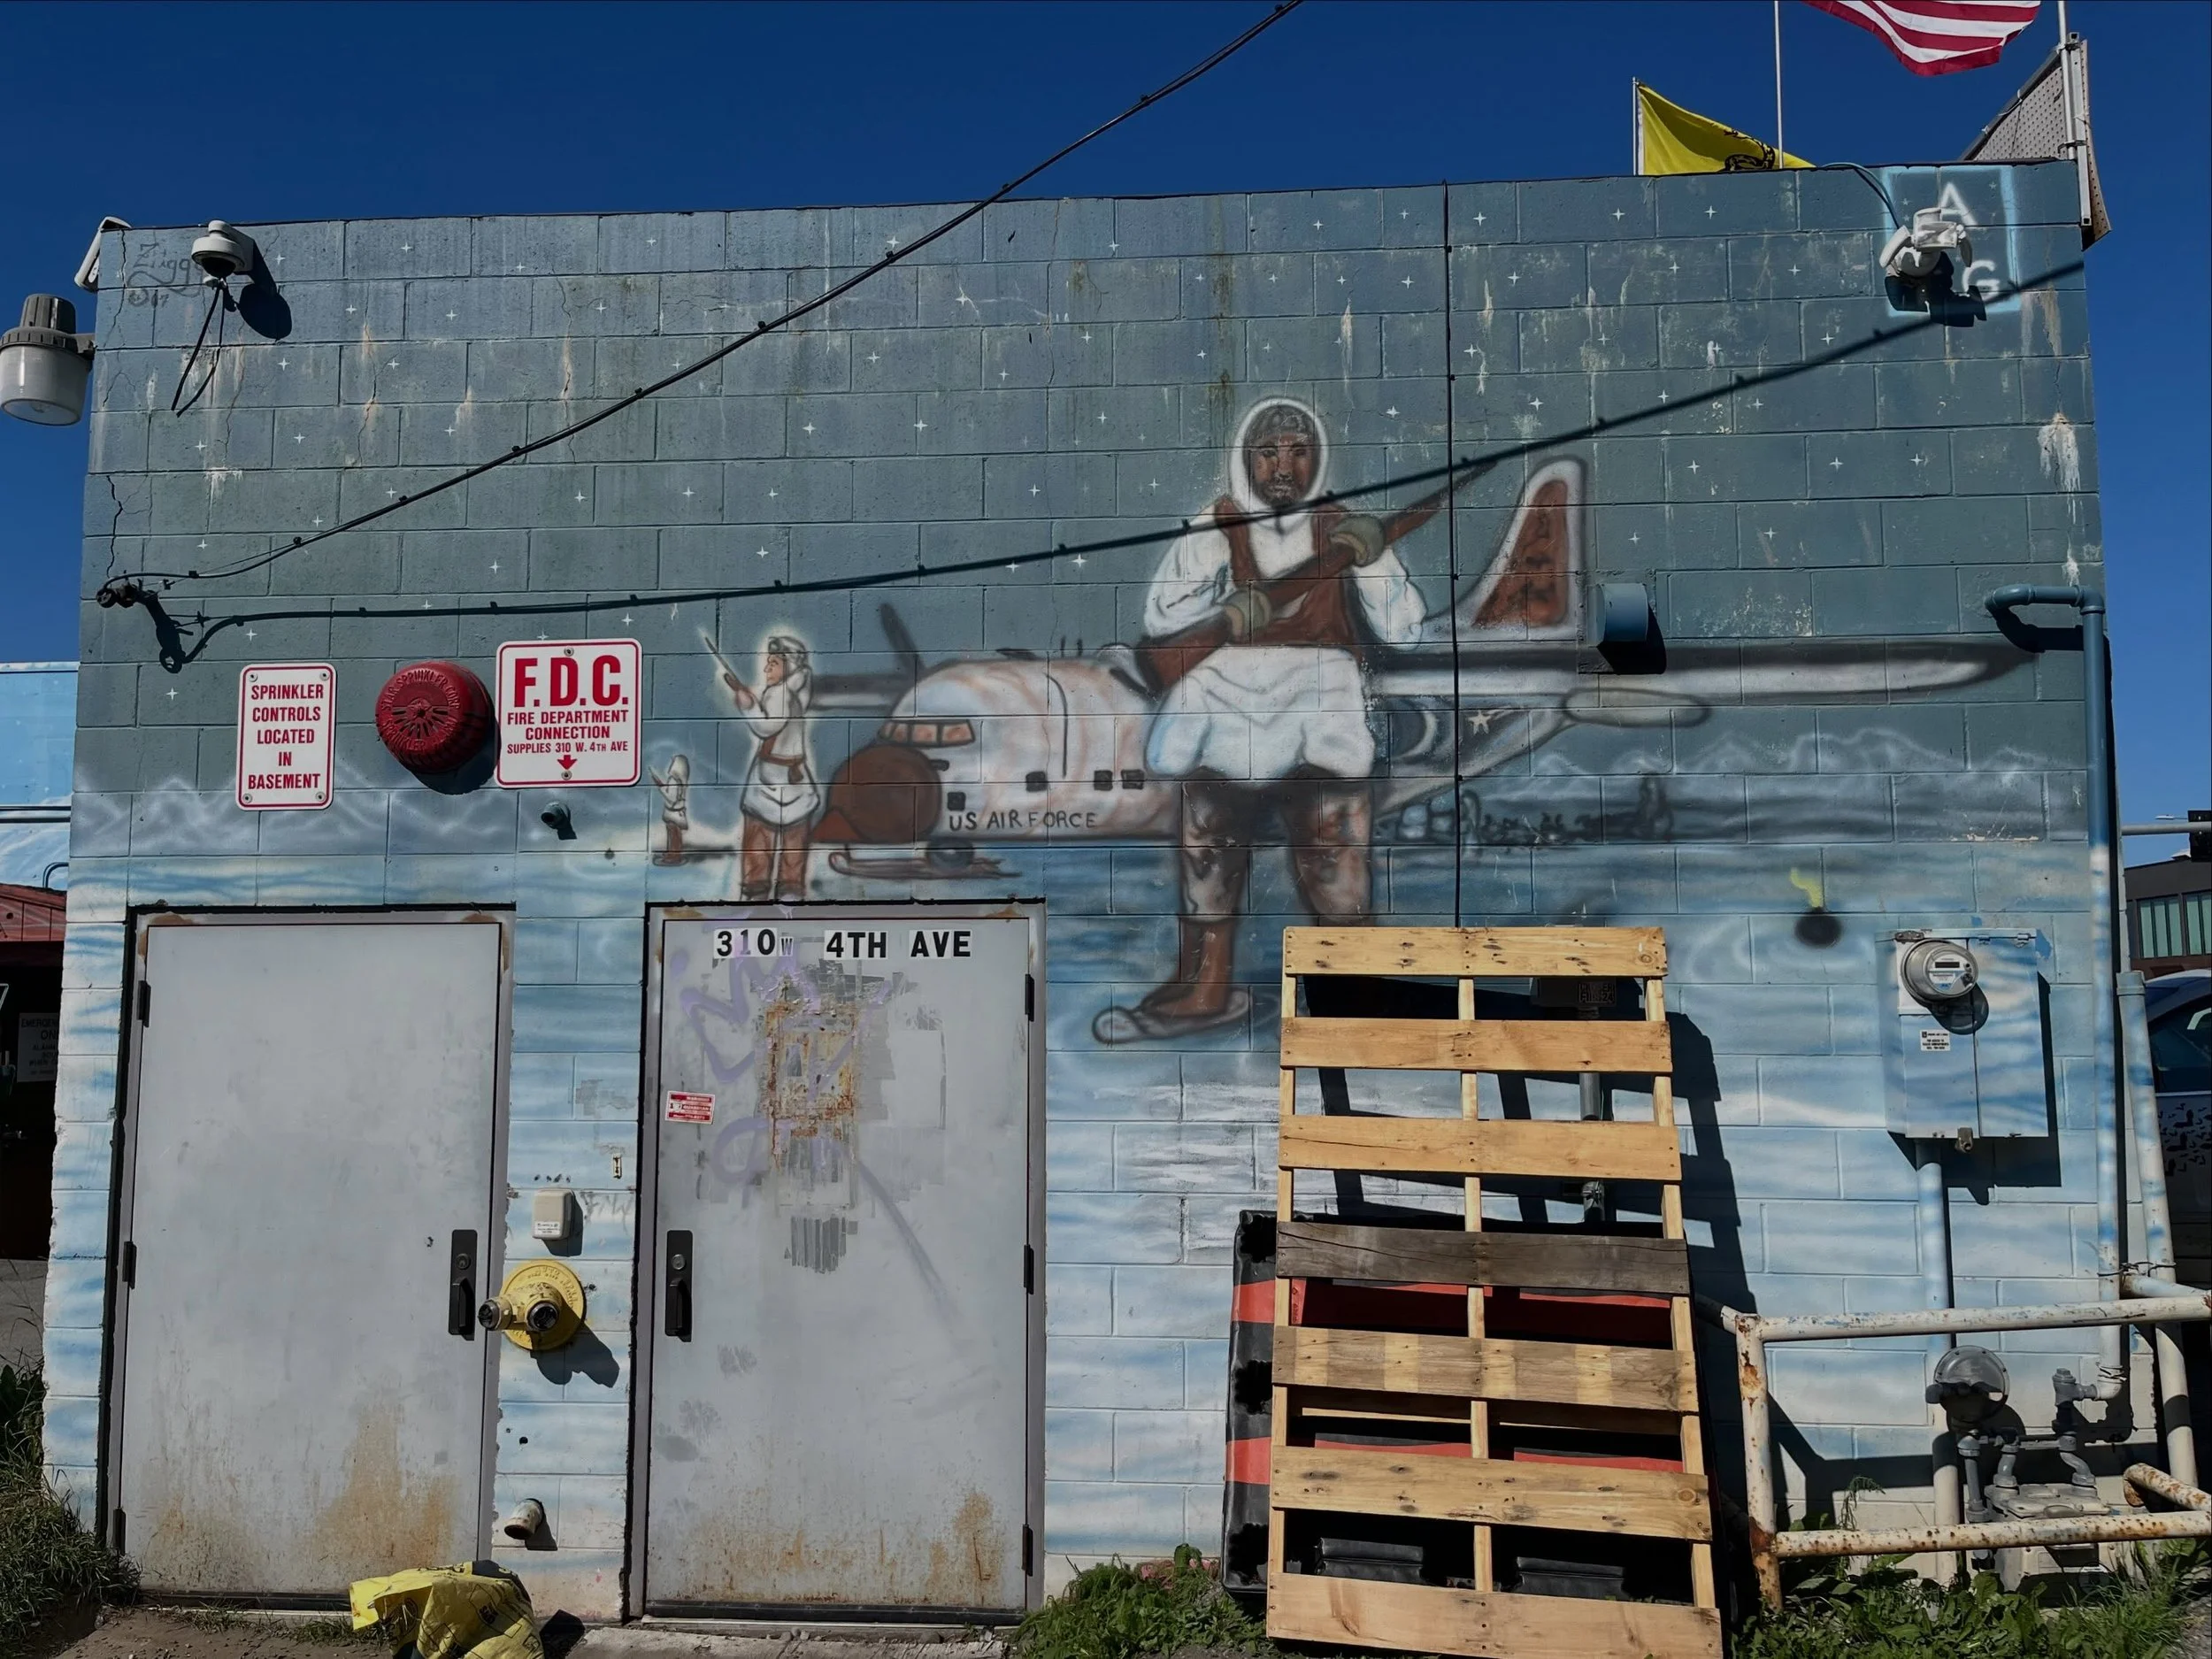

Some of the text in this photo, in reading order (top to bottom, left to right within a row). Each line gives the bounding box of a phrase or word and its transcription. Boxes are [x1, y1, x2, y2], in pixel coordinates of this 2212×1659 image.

[514, 655, 629, 708] F.D.C.
[250, 684, 324, 700] SPRINKLER
[252, 706, 321, 722] CONTROLS
[507, 710, 629, 725] FIRE DEPARTMENT
[257, 728, 315, 744] LOCATED
[526, 726, 611, 740] CONNECTION
[507, 743, 551, 754] SUPPLIES
[555, 742, 572, 753] 310
[575, 741, 588, 752] W.
[611, 741, 628, 751] AVE
[278, 751, 292, 766] IN
[248, 773, 321, 790] BASEMENT
[949, 809, 1098, 831] US AIR FORCE
[717, 929, 971, 958] 310 W 4TH AVE
